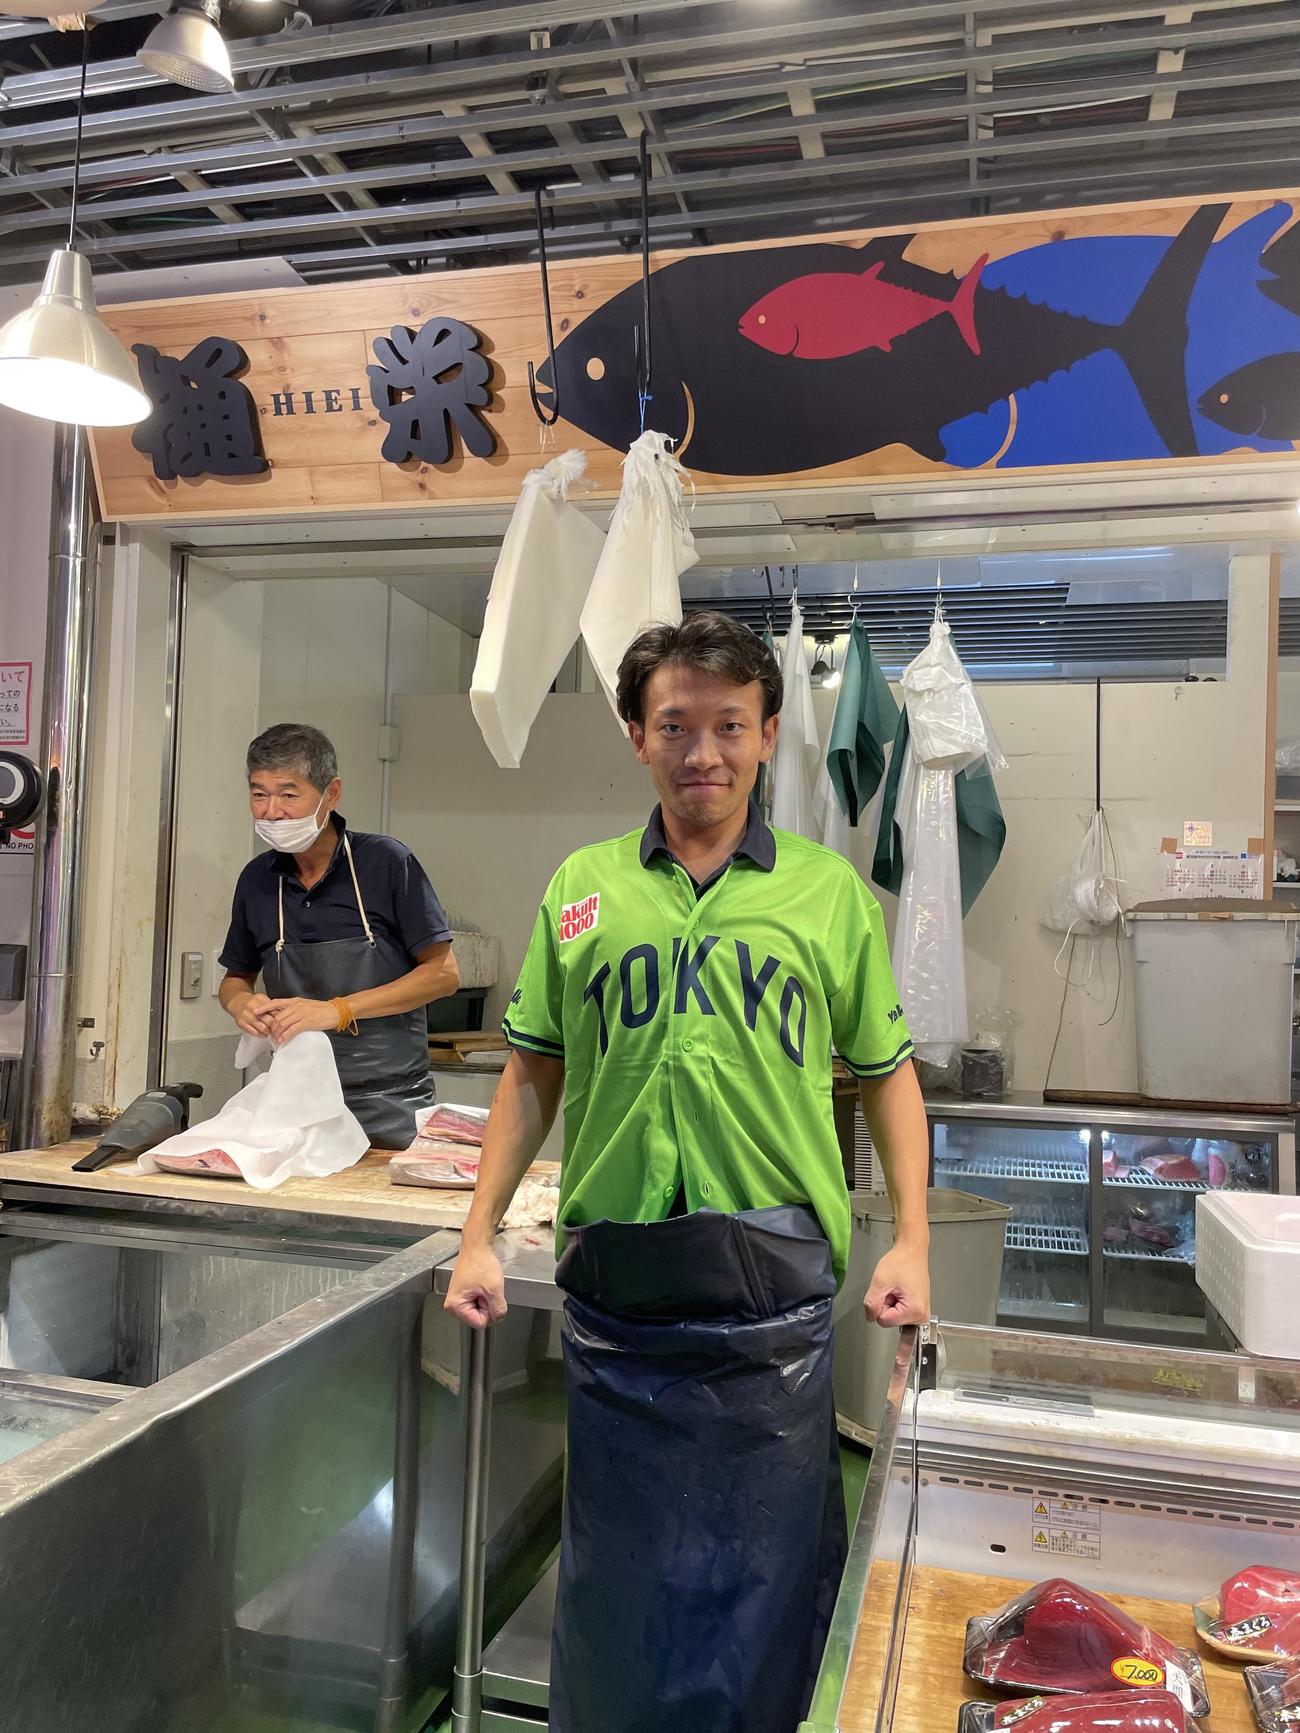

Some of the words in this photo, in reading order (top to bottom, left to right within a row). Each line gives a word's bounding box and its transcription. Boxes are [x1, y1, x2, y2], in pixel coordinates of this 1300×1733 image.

[270, 387, 364, 417] HIEI
[584, 935, 806, 1068] TOKYO
[1230, 1616, 1271, 1638] 本まぐろ
